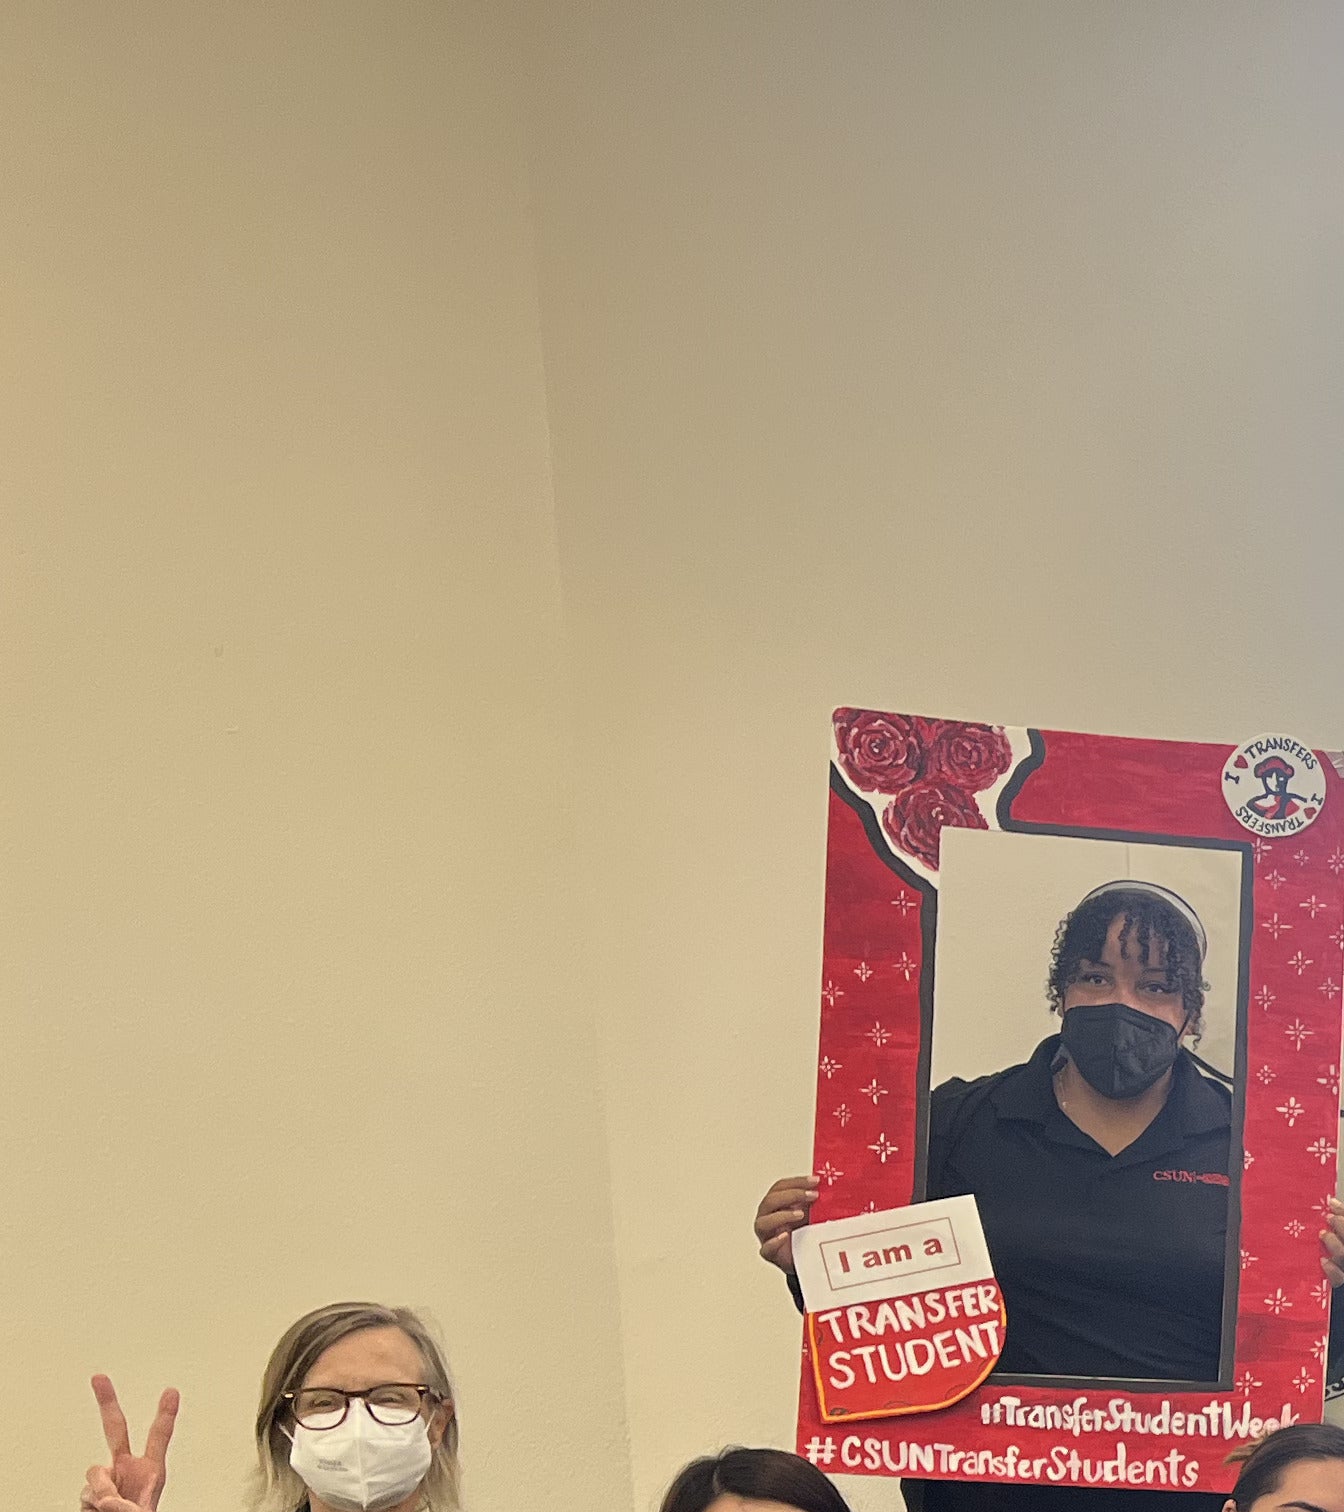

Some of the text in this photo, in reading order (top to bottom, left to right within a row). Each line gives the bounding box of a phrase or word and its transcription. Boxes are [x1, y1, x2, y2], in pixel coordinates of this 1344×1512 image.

[1244, 738, 1317, 770] TRANSFERS
[838, 1237, 943, 1274] I am a
[818, 1285, 1000, 1344] TRANSFER
[828, 1320, 1000, 1390] STUDENT
[804, 1435, 1200, 1488] #CSUNTransferStudents
